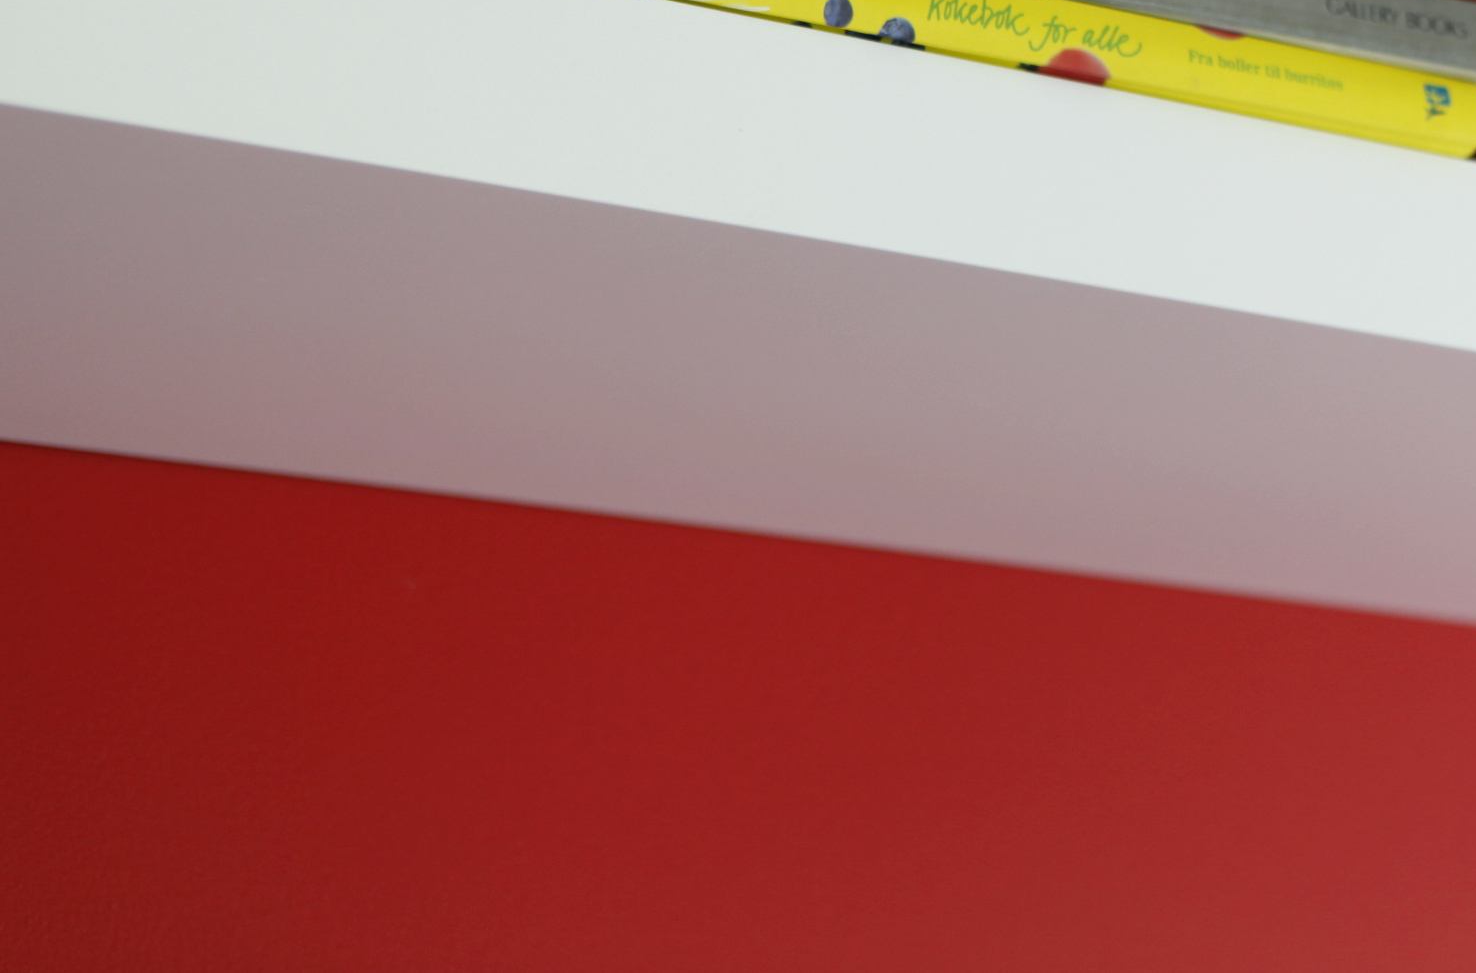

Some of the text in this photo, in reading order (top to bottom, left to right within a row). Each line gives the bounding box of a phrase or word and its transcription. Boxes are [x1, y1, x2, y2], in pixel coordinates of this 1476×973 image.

[1029, 15, 1077, 52] for
[1082, 24, 1143, 58] alle
[1405, 11, 1469, 40] BOOKS
[1188, 49, 1344, 91] Fra boller til burritos
